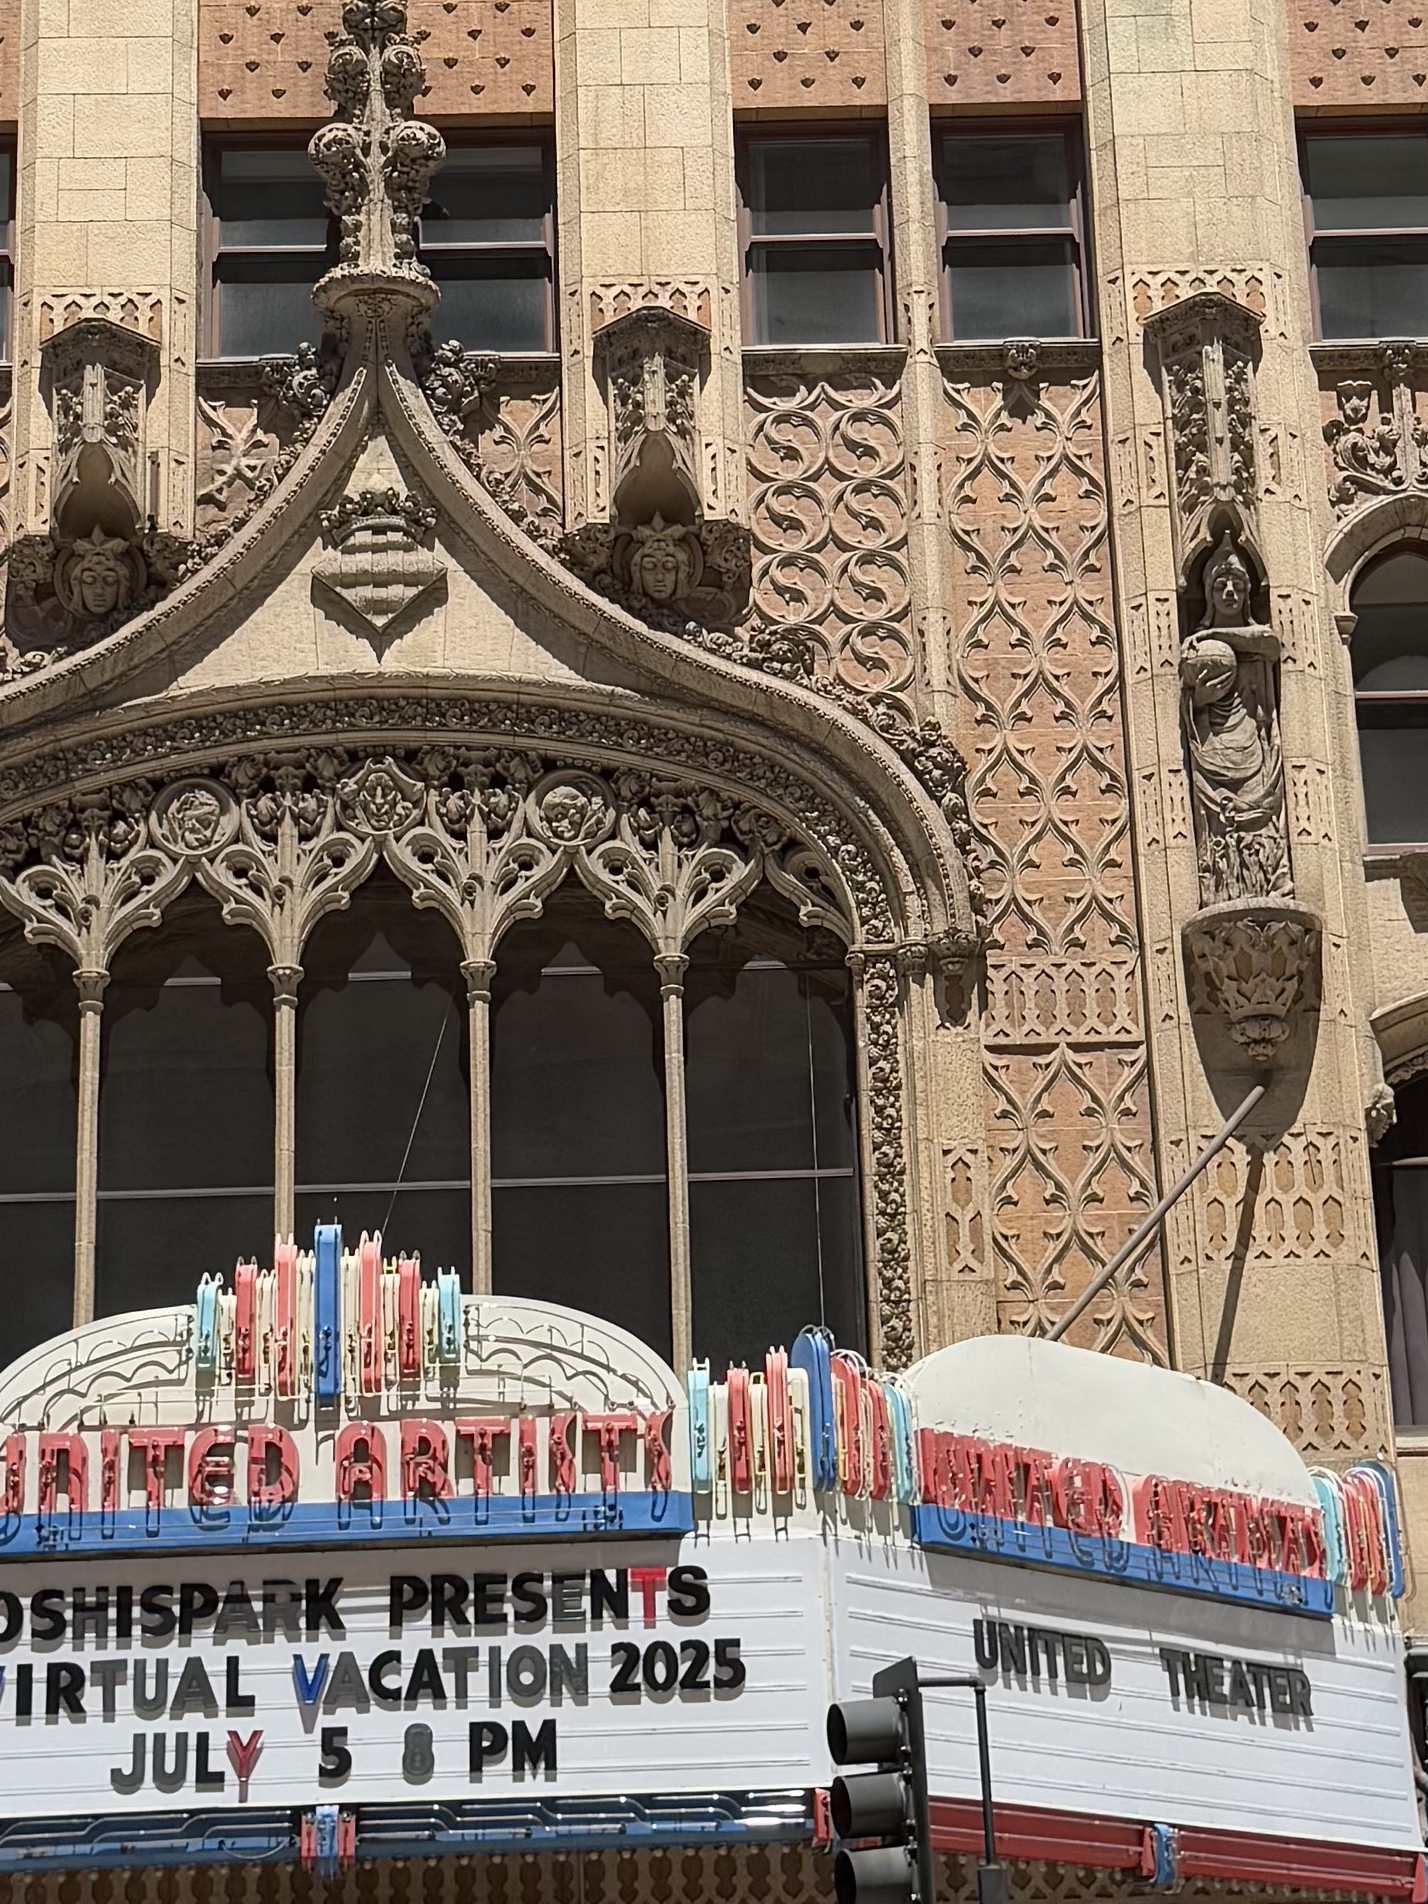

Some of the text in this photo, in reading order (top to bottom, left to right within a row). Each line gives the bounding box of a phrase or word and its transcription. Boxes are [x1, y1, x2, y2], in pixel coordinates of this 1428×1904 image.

[334, 1412, 673, 1502] ARTISTS
[390, 1565, 711, 1630] PRESENTS
[292, 1641, 589, 1705] VACATION
[609, 1637, 747, 1694] 2025
[973, 1619, 1314, 1716] UNITED THEATER
[110, 1718, 558, 1787] JULY 5 8 PM
